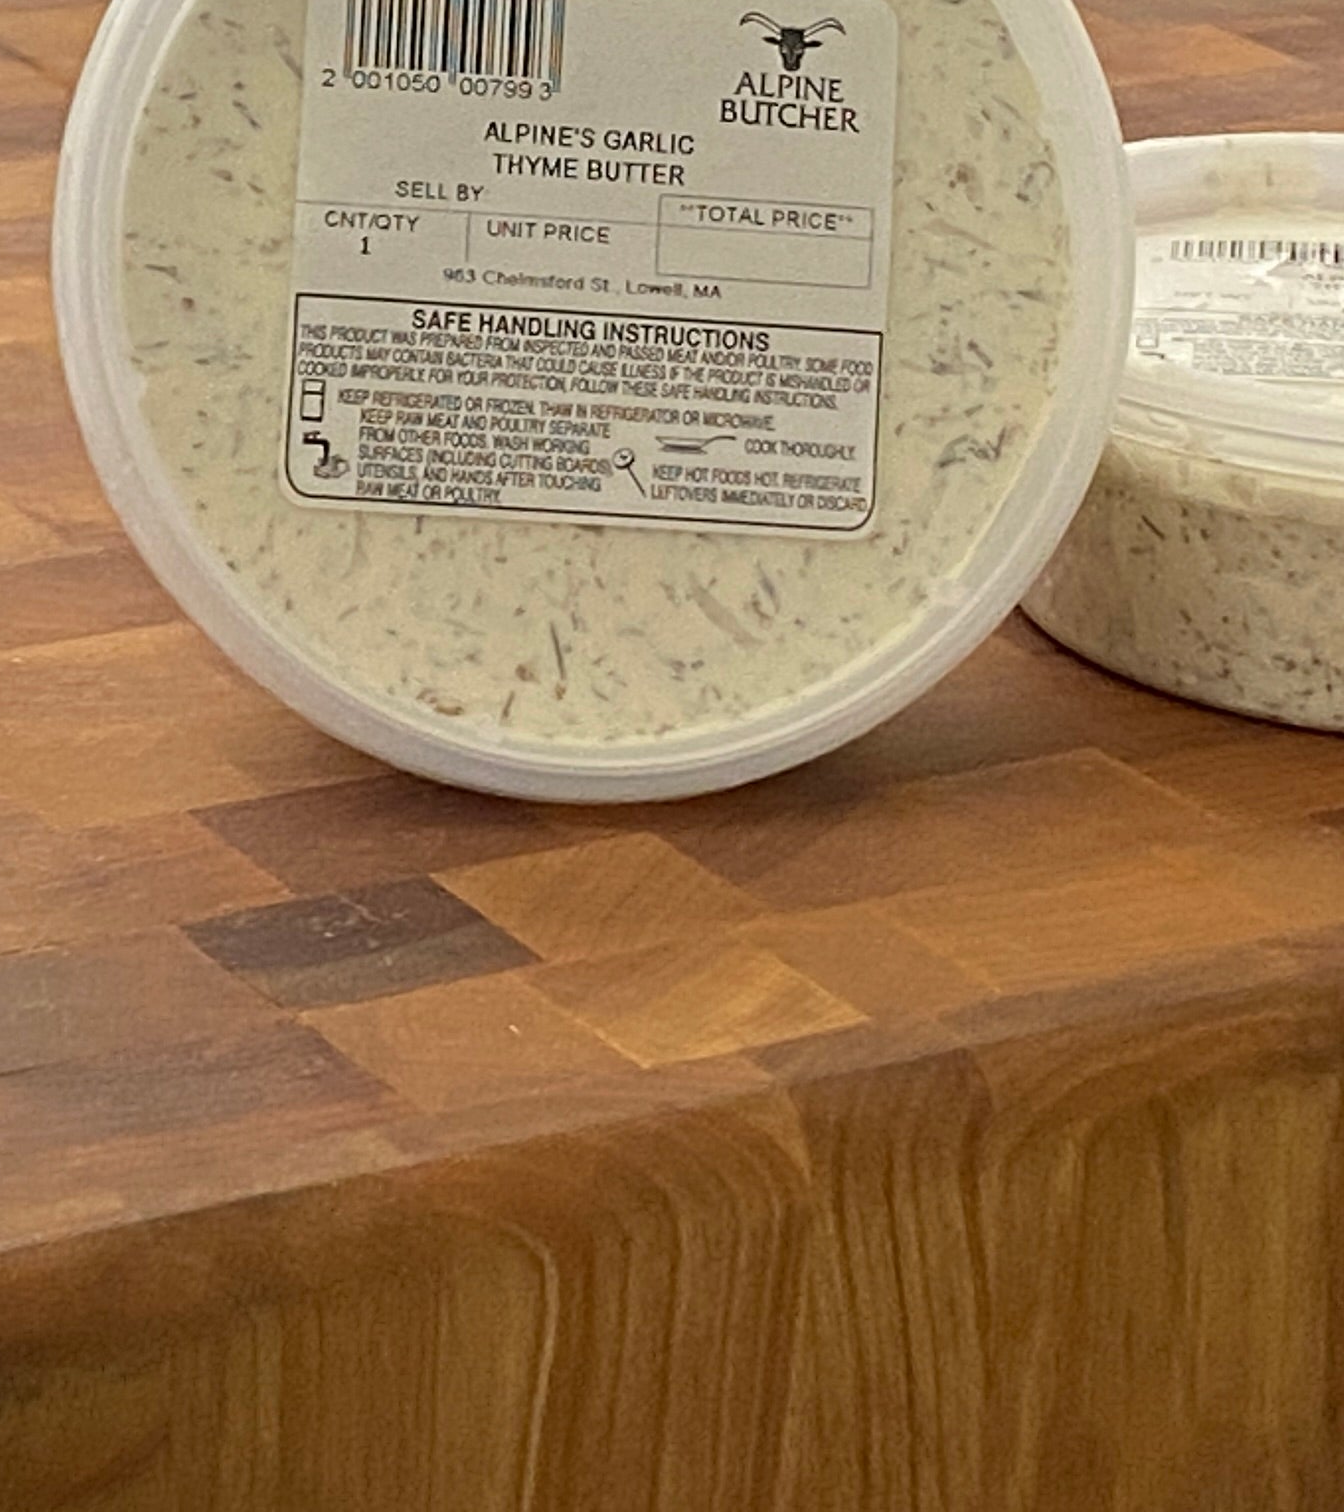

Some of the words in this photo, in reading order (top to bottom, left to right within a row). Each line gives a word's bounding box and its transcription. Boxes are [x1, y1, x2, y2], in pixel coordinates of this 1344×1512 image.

[321, 67, 336, 87] 2
[351, 69, 440, 94] 001050
[734, 70, 844, 103] ALPINE
[719, 98, 859, 133] BUTCHER
[484, 120, 595, 149] ALPINE'S
[604, 128, 694, 155] GARLIC
[493, 152, 578, 179] THYME
[587, 159, 684, 186] BUTTER
[395, 179, 447, 201] SELL
[457, 183, 483, 203] BY
[324, 208, 419, 232] CNT/QTY
[486, 219, 536, 239] UNIT
[544, 223, 610, 244] PRICE
[360, 235, 370, 255] 1
[693, 283, 722, 300] MA
[412, 308, 471, 332] SAFE
[479, 313, 594, 340] HANDLING
[603, 321, 768, 351] INSTRUCTIONS
[301, 323, 326, 340] THIS
[329, 325, 387, 344] PRODUCT
[391, 329, 416, 346] WAS
[420, 331, 482, 350] PREPARED
[486, 335, 519, 353] FROM
[524, 338, 588, 357] INSPECTED
[591, 342, 616, 359] AND
[618, 344, 664, 362] PASSED
[667, 347, 698, 365] MEAT
[805, 356, 837, 374] SOME
[840, 359, 872, 376] FOOD
[298, 340, 361, 360] PRODUCTS
[366, 345, 390, 362] MAY
[392, 347, 442, 365] CONTAIN
[446, 350, 502, 369] BACTERIA
[505, 354, 533, 371] THAT
[537, 356, 575, 374] COULD
[578, 359, 616, 377] CAUSE
[621, 362, 665, 380] ILLNESS
[669, 365, 680, 381] IF
[682, 366, 704, 383] THE
[708, 368, 762, 387] PRODUCT
[766, 372, 776, 387] IS
[779, 373, 850, 392] MISHANDLED
[852, 378, 869, 394] OR
[360, 407, 392, 425] KEEP
[396, 409, 423, 427] RAW
[427, 411, 460, 429] MEAT
[461, 414, 486, 431] AND
[490, 416, 545, 435] POULTRY
[549, 420, 610, 439] SEPARATE
[358, 425, 394, 443] FROM
[398, 427, 440, 446] OTHER
[493, 434, 527, 452] WASH
[533, 436, 589, 456] WORKING
[744, 438, 776, 455] COOK
[358, 443, 422, 463] SURFACES
[500, 452, 552, 472] CUTTING
[423, 465, 447, 483] AND
[451, 467, 492, 486] HANDS
[496, 470, 534, 489] AFTER
[538, 473, 601, 493] TOUCHING
[652, 463, 682, 481] KEEP
[685, 466, 708, 483] HOT
[712, 467, 751, 486] FOODS
[782, 472, 860, 493] REFRIGERATE
